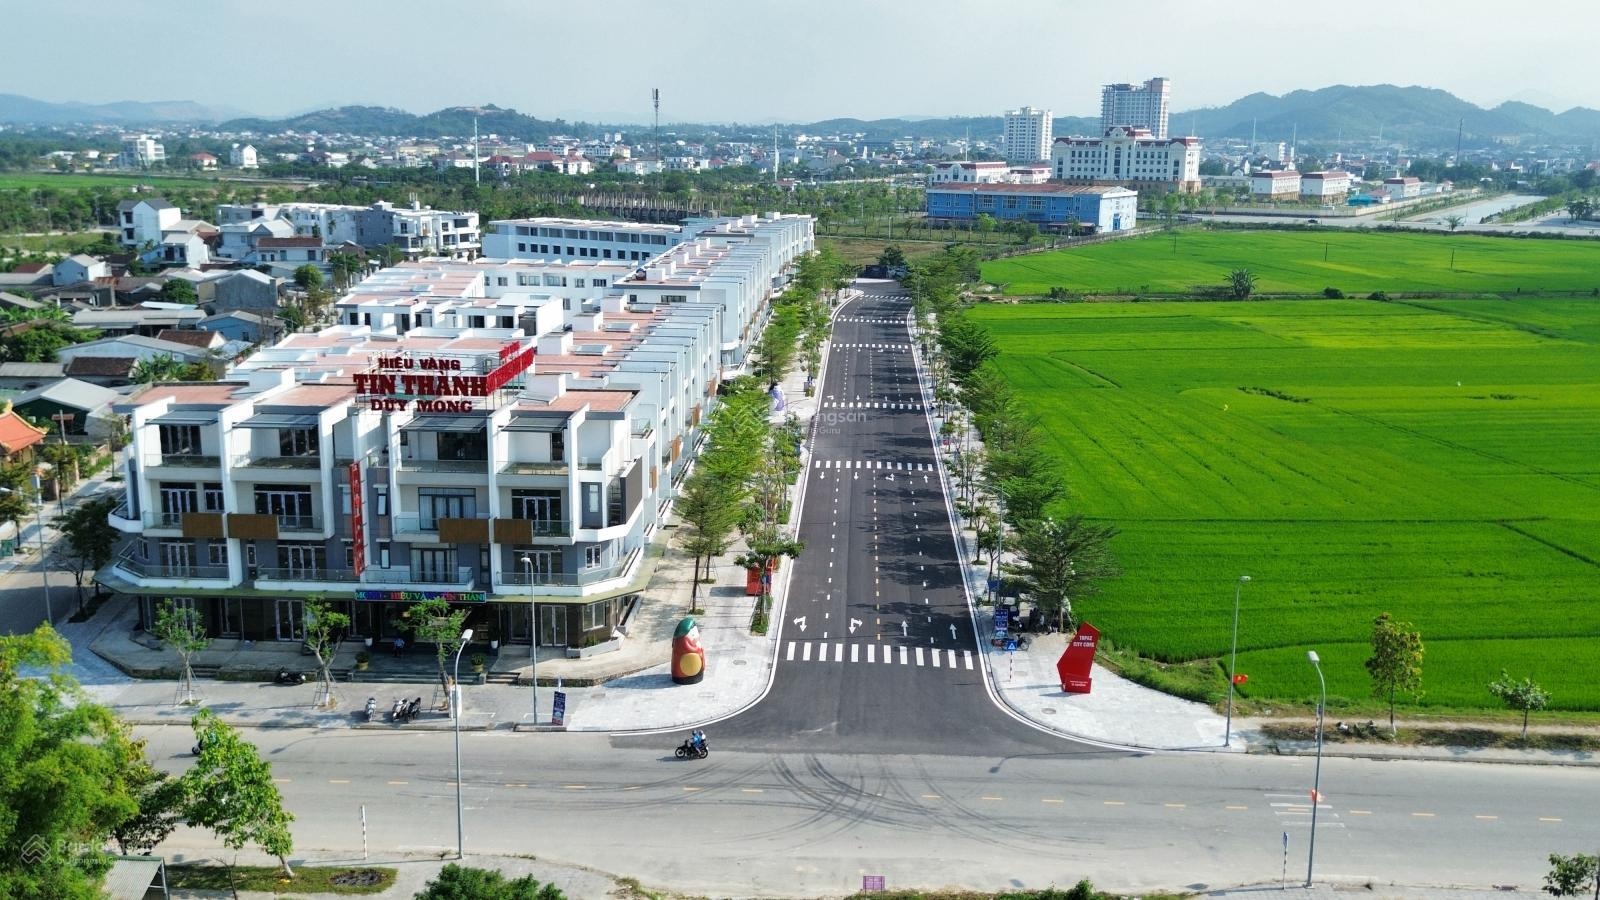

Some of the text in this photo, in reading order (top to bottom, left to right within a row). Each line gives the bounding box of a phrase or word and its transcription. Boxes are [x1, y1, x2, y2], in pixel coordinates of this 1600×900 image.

[419, 357, 461, 370] VÀNG
[353, 369, 396, 394] TÍN
[401, 370, 487, 396] THÀNH
[371, 399, 473, 412] DUY MONG
